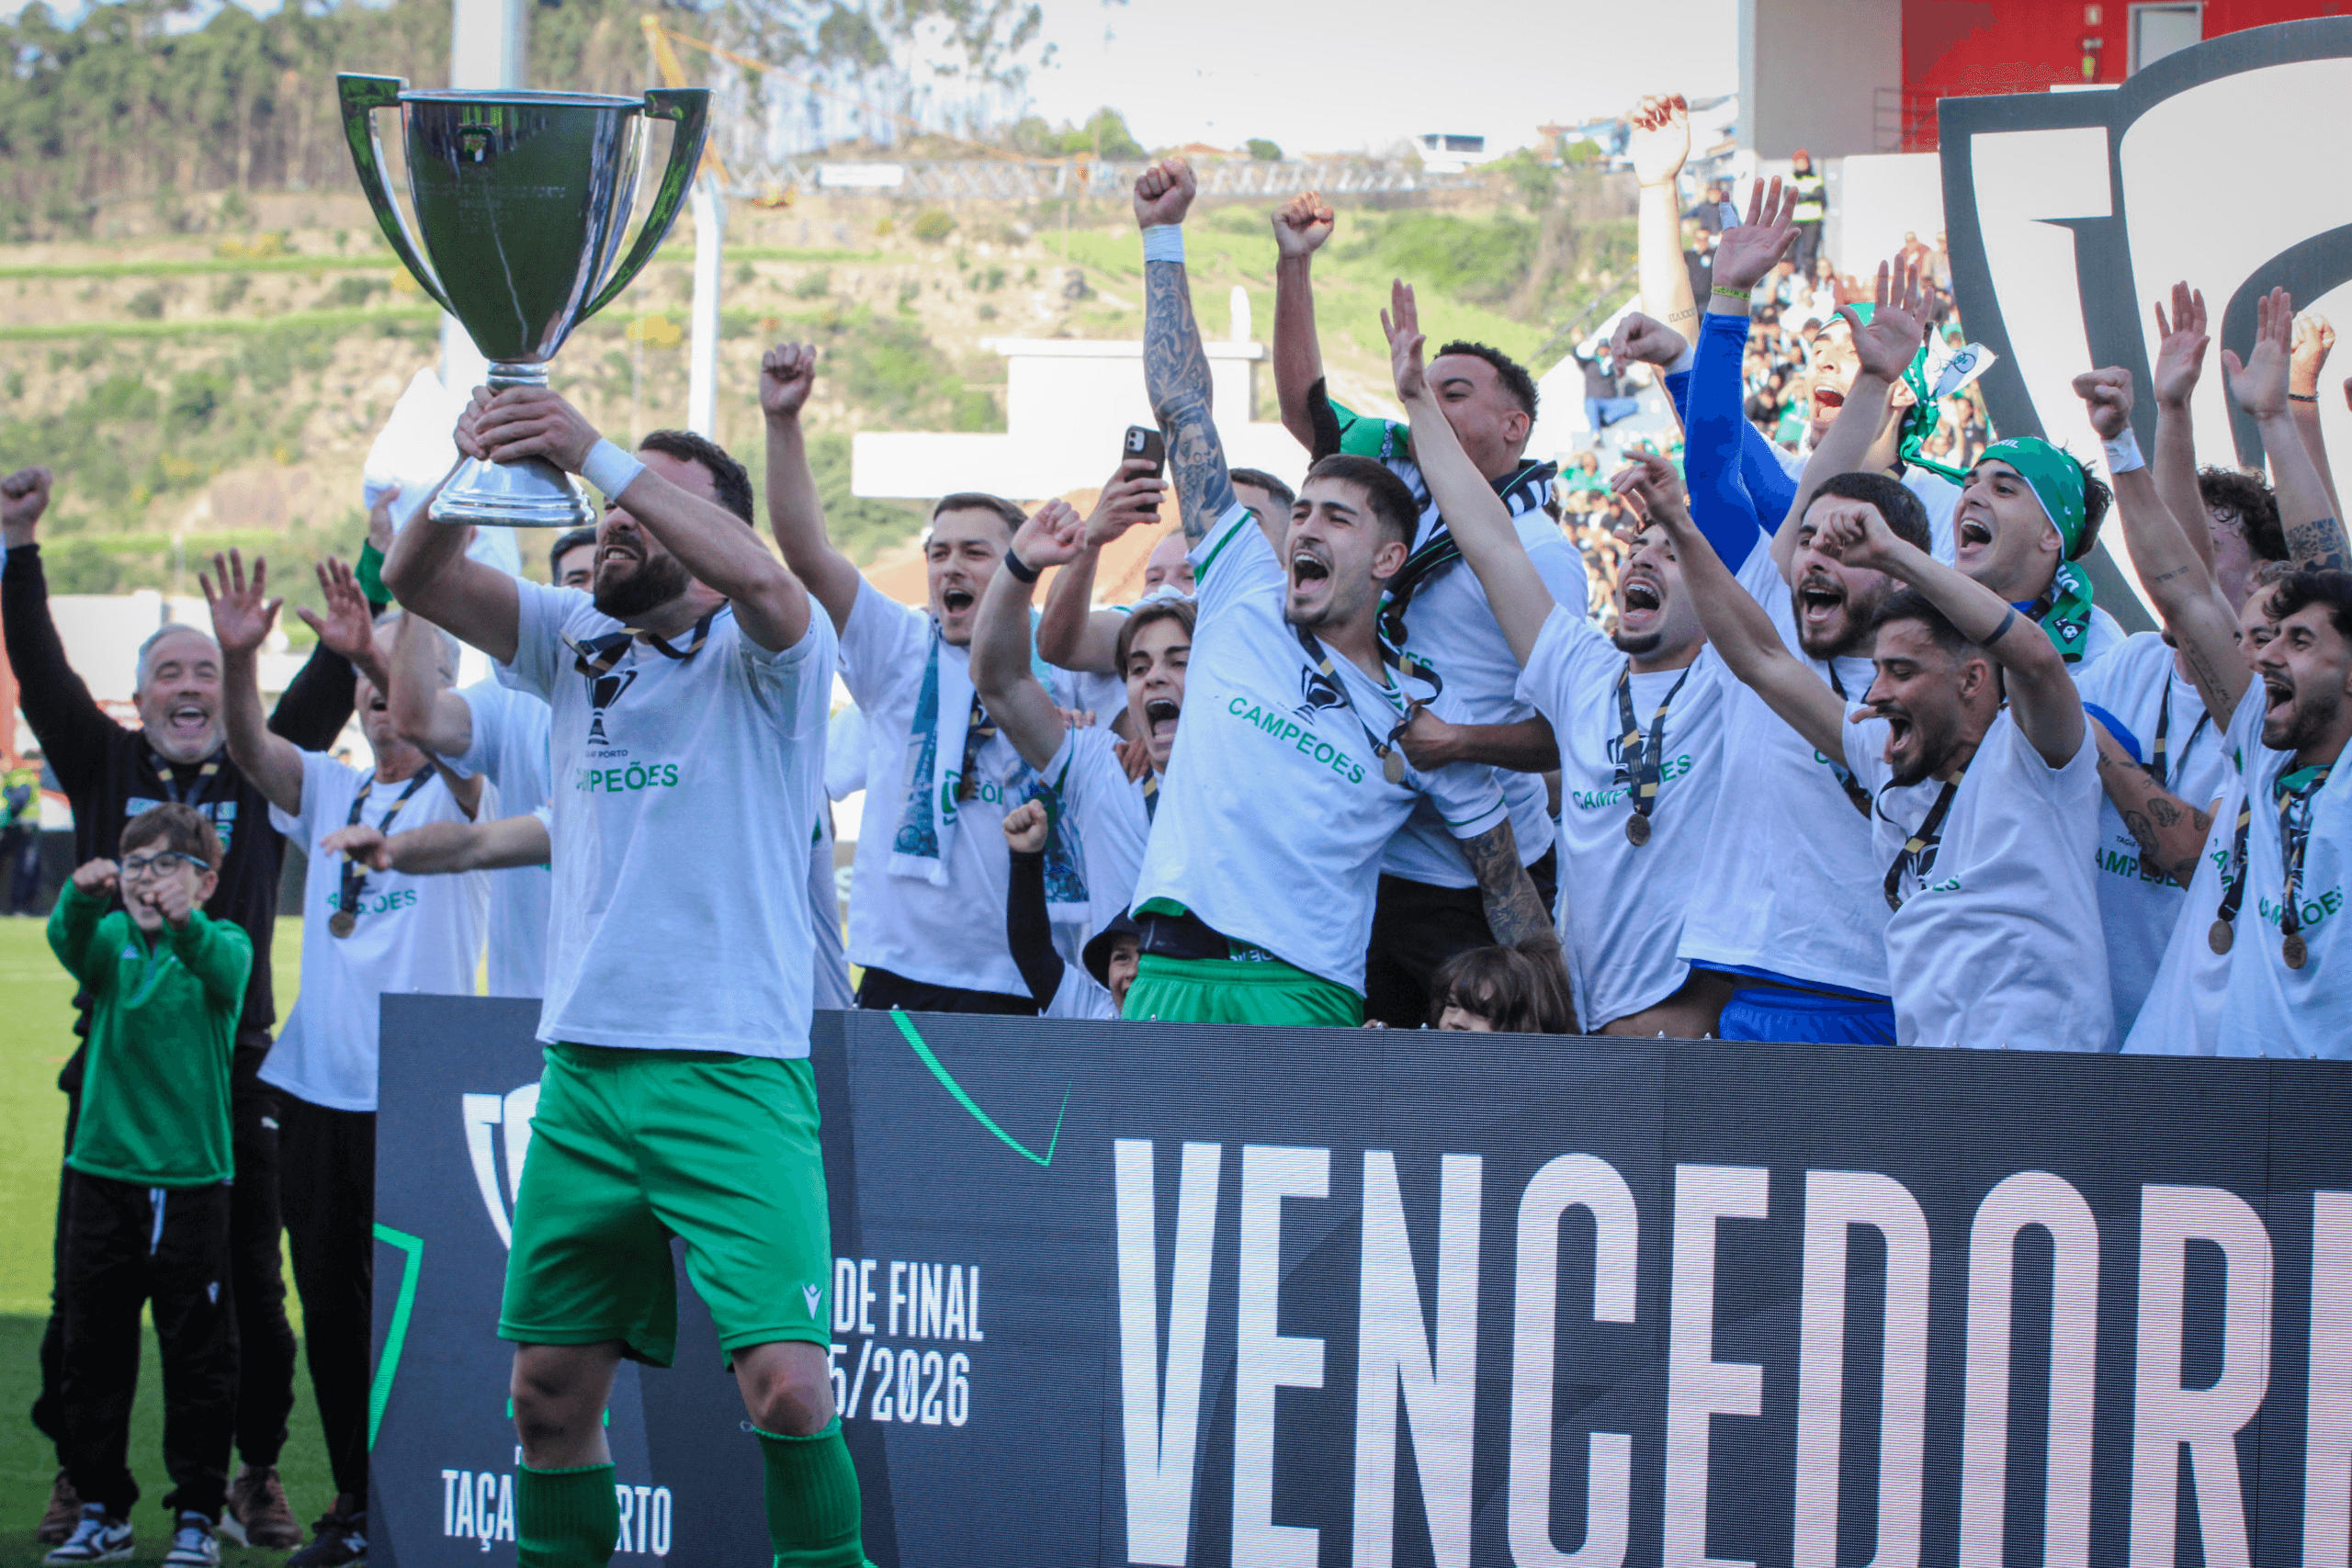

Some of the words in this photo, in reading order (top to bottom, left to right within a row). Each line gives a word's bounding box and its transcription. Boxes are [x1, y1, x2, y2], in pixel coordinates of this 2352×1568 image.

[834, 1258, 877, 1335] DE
[888, 1260, 985, 1342] FINAL
[827, 1338, 970, 1427] 5/2026
[441, 1468, 516, 1552] TAÇA
[615, 1483, 673, 1557] RTO
